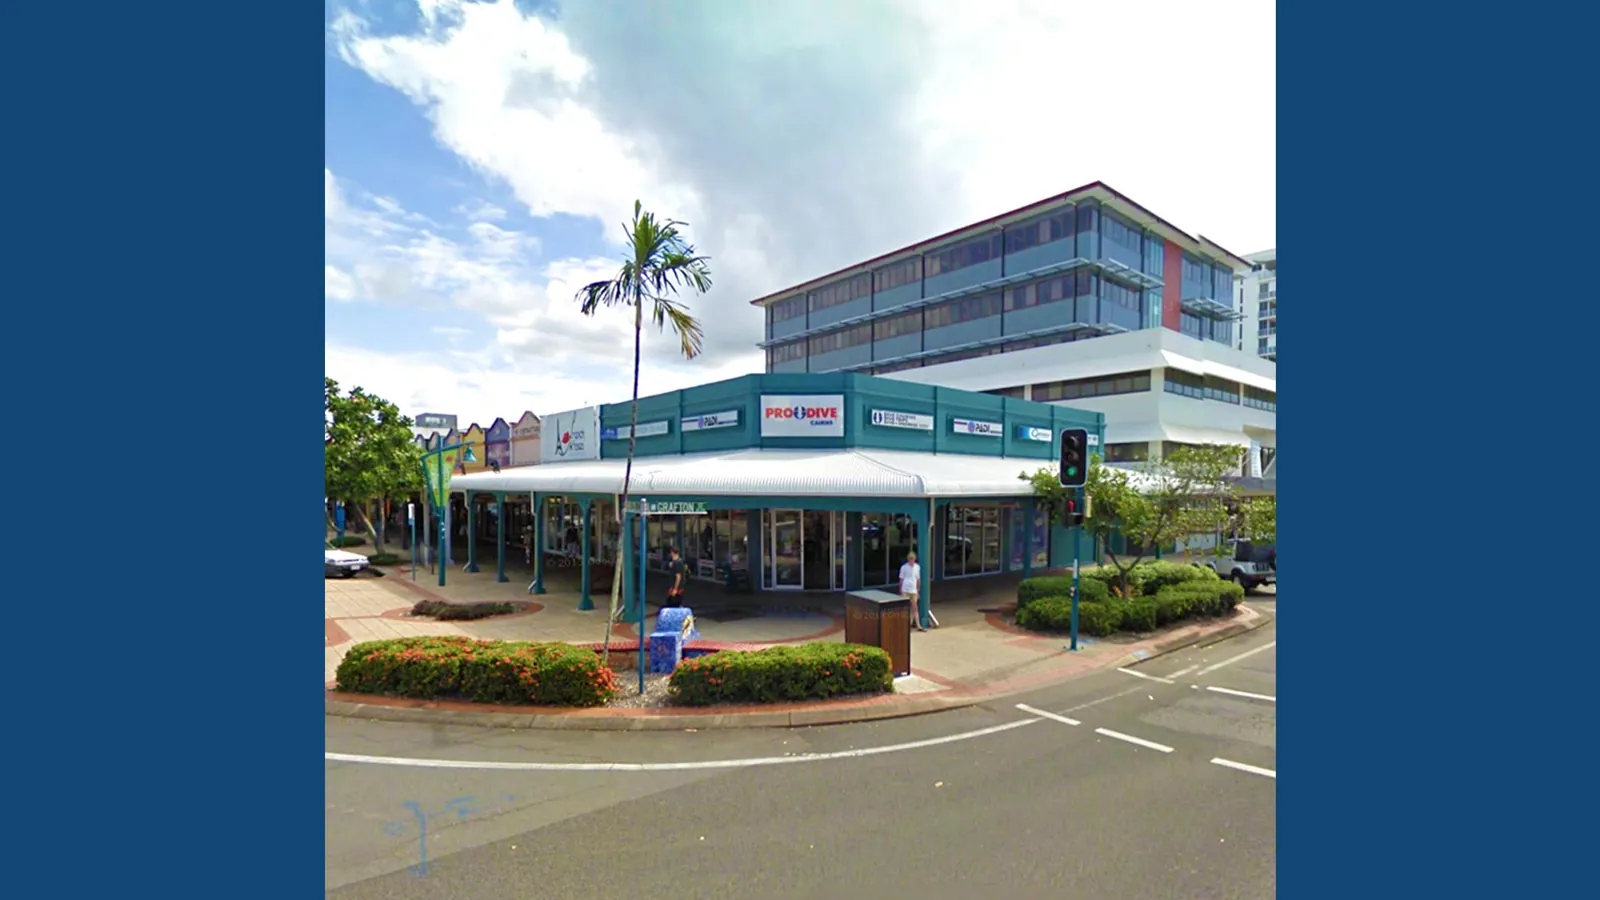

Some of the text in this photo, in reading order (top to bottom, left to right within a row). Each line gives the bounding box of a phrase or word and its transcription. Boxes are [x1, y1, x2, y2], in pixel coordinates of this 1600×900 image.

[765, 407, 837, 418] PRO DIVE
[975, 423, 990, 433] PADI
[657, 502, 694, 512] GRAFTON
